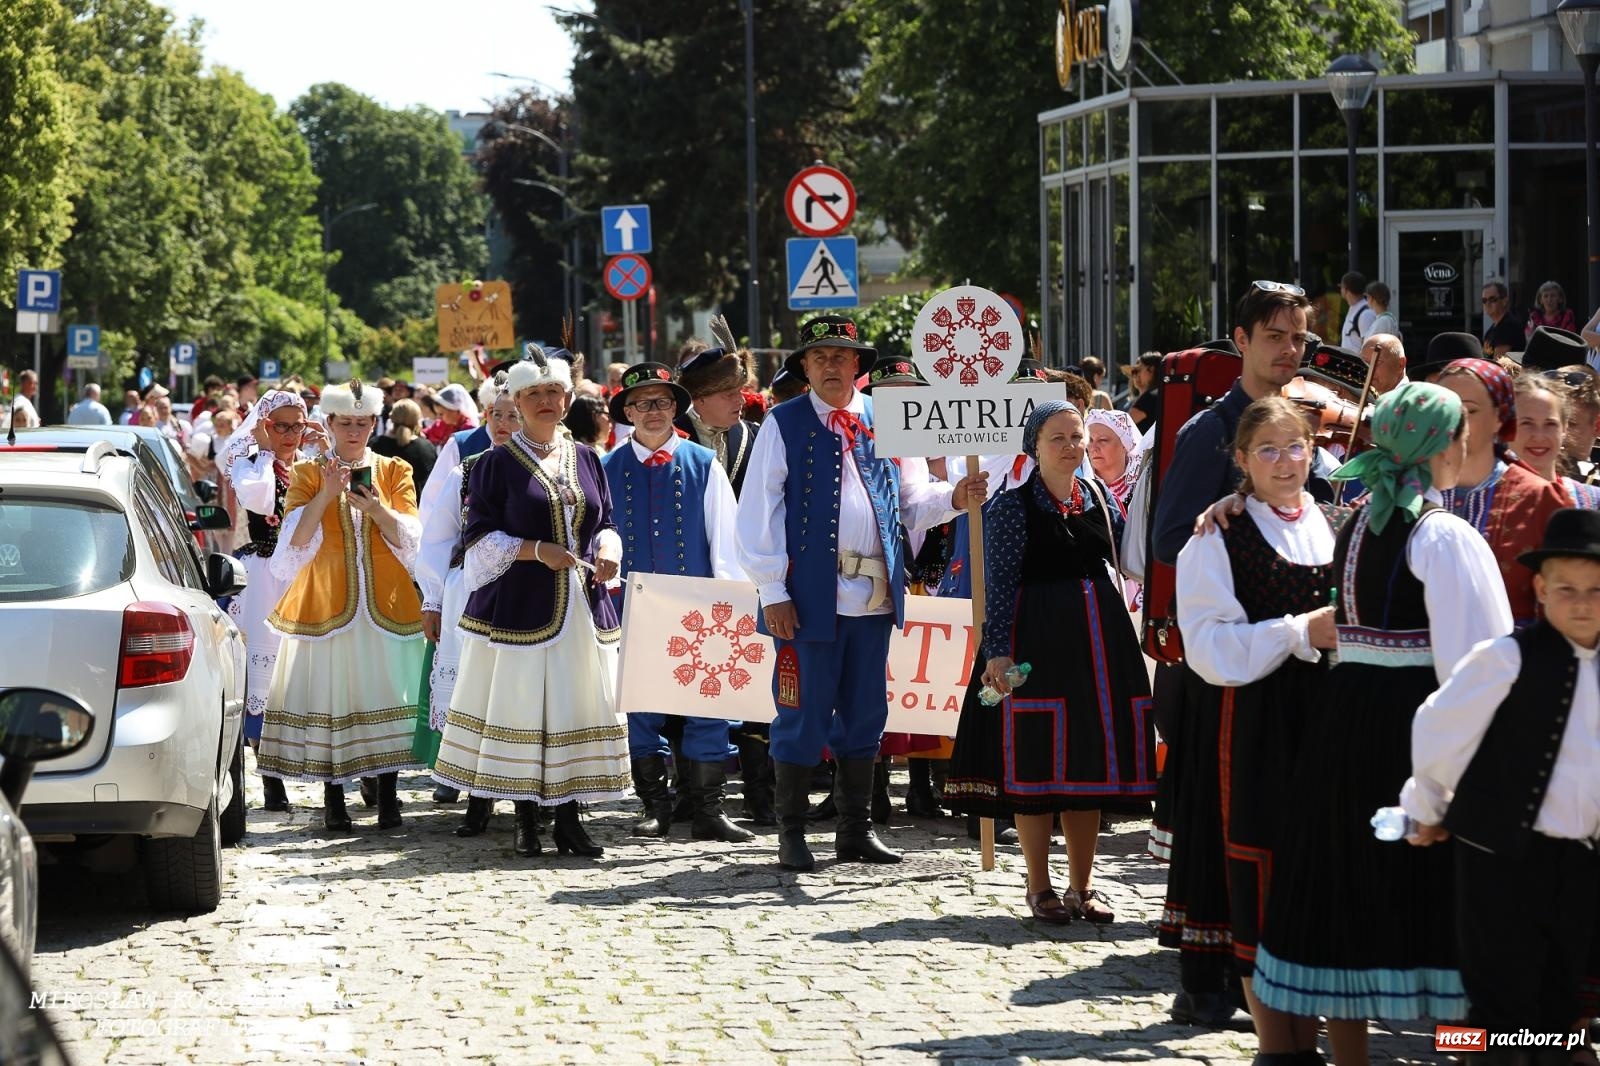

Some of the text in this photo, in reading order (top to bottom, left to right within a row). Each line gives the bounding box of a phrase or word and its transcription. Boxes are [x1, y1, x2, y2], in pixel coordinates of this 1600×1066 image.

[1424, 264, 1452, 278] Vena
[27, 274, 51, 307] P
[75, 329, 93, 353] P
[178, 345, 193, 362] P
[264, 361, 276, 376] P
[901, 397, 1037, 431] PATRIA
[937, 431, 1008, 445] KATOWICE
